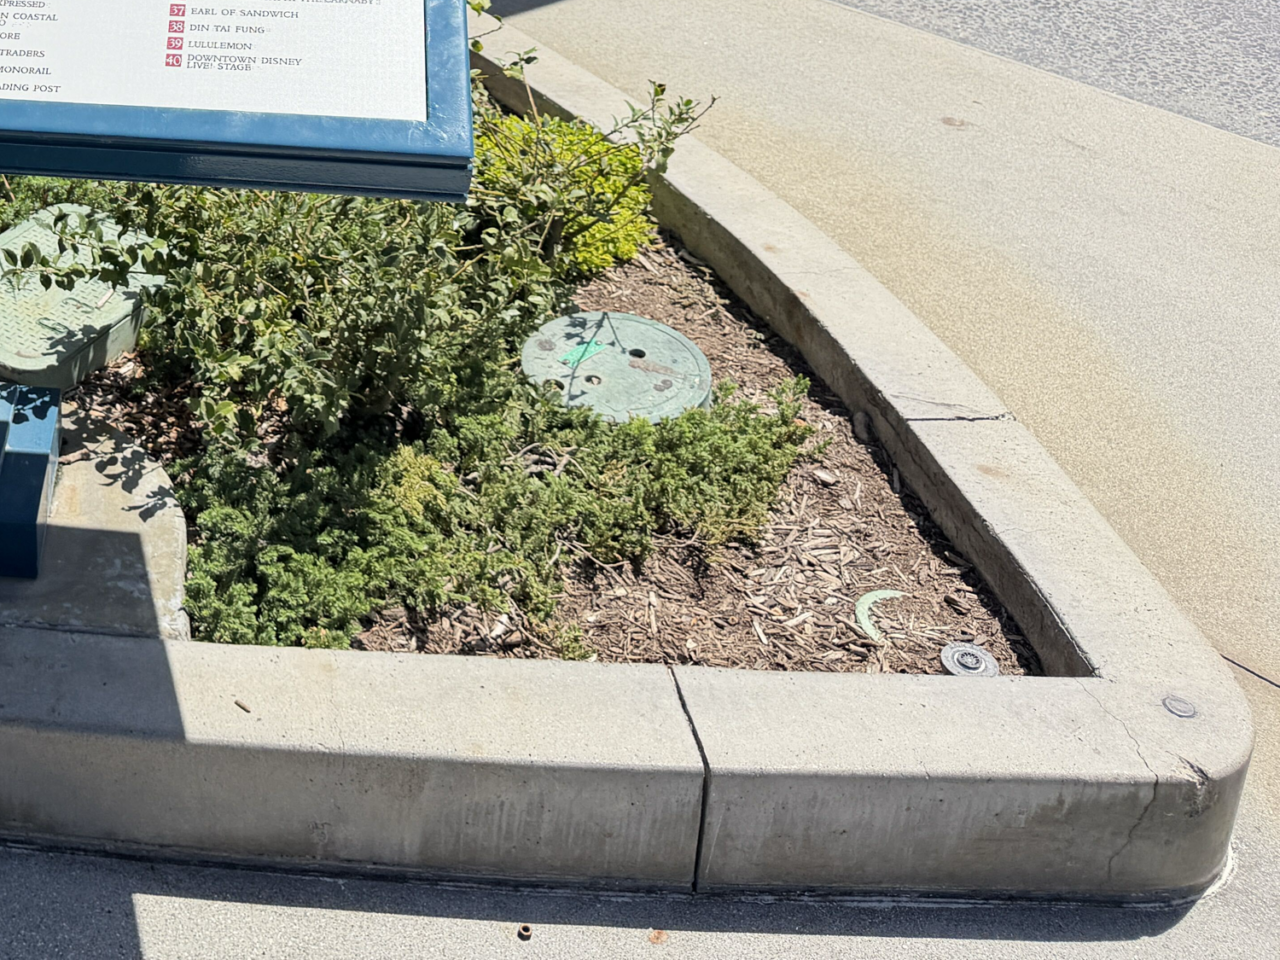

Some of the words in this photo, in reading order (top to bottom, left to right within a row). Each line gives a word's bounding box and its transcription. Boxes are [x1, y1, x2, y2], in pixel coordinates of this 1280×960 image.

[172, 6, 184, 15] 37
[240, 10, 299, 18] SANDWICH
[170, 22, 183, 31] 38
[168, 39, 182, 48] 39
[188, 41, 252, 50] LULULEMON
[0, 49, 45, 57] TRADERS
[33, 85, 61, 93] POST
